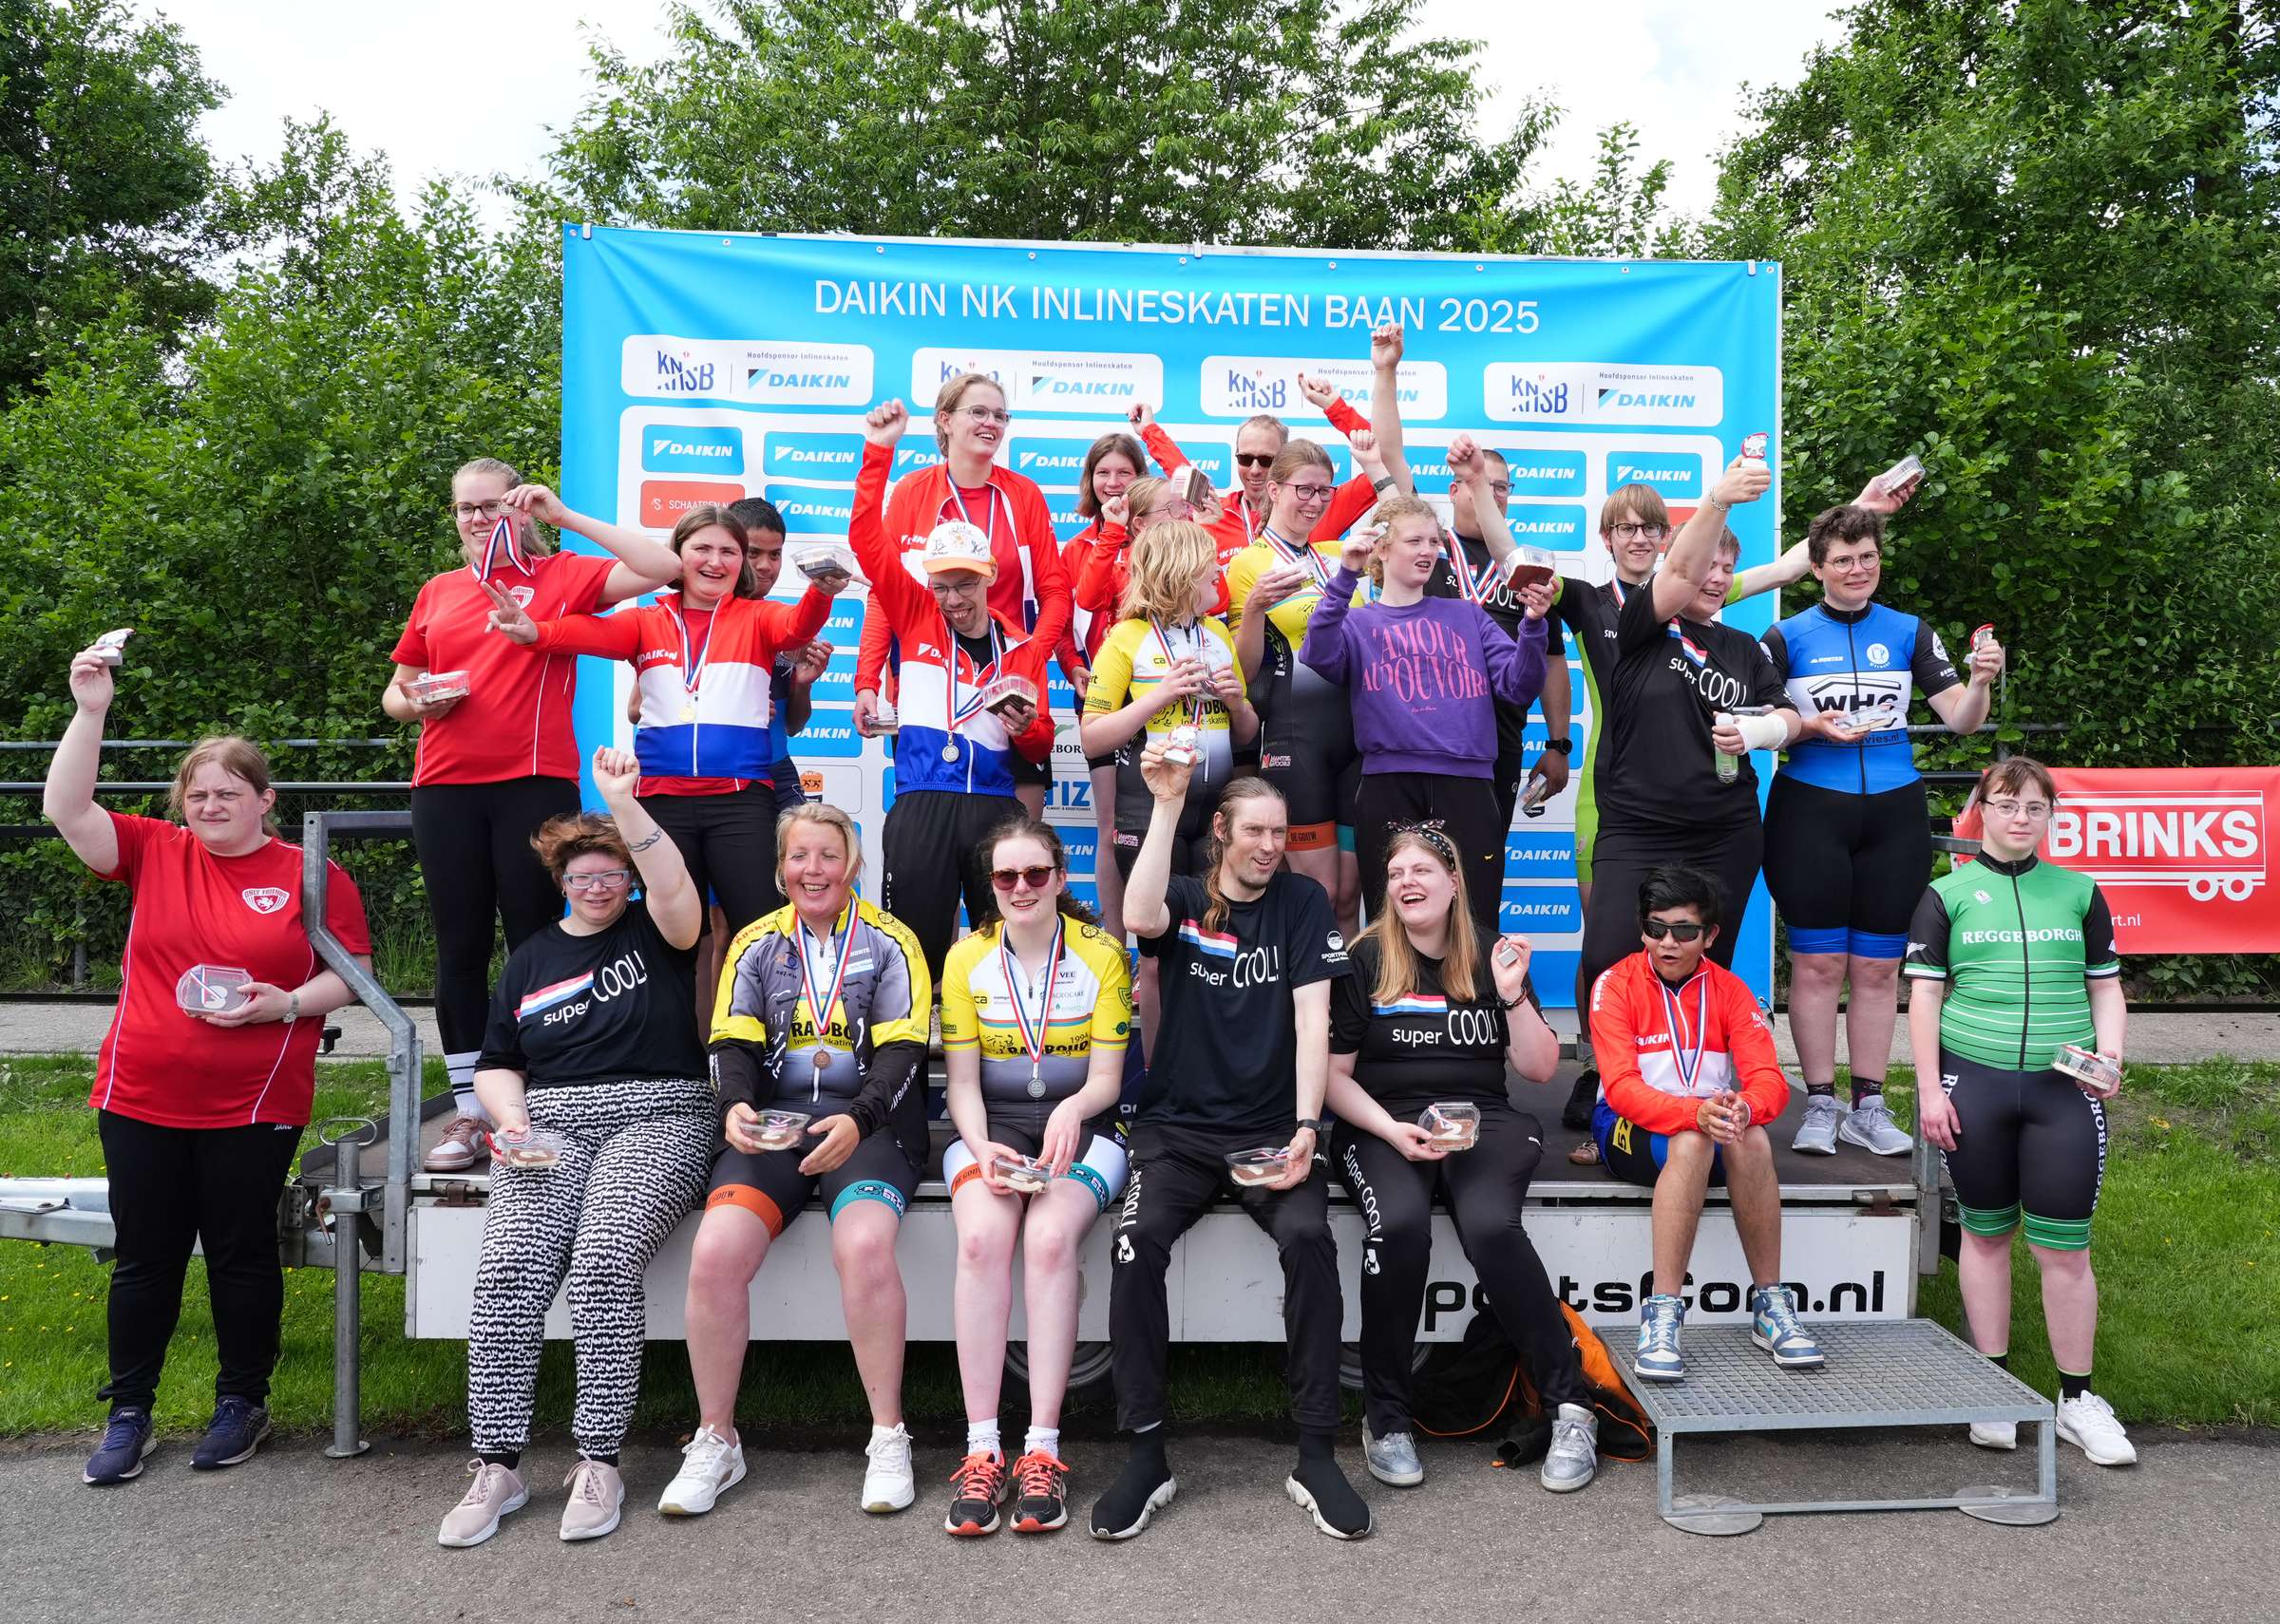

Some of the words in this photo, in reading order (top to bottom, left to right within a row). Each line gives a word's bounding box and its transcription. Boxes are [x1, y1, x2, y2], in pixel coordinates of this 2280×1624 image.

[814, 279, 945, 316] DAIKIN
[961, 284, 1018, 318] NK
[1033, 286, 1309, 327] INLINESKATEN
[1324, 293, 1425, 330] BAAN
[1438, 297, 1540, 334] 2025
[747, 350, 799, 361] Hoofdsponsor
[800, 352, 849, 362] Inlineskaten
[1032, 359, 1084, 370] Hoofdsponsor
[1085, 361, 1133, 370] Inlineskaten
[768, 372, 850, 388] DAIKIN
[1318, 368, 1369, 378] Hoofdsponsor
[1598, 371, 1647, 382] Hoofdsponsor
[1052, 381, 1134, 396] DAIKIN
[1339, 388, 1418, 403] DAIN
[1617, 393, 1696, 408] DAIKIN
[669, 443, 732, 458] DAIKIN
[790, 449, 855, 463] DAIKIN
[1035, 455, 1085, 468] DAIKI
[1515, 466, 1576, 480] DAIKIN
[1633, 469, 1692, 482] DAIKIN
[1513, 520, 1576, 534] DAIKIN
[2048, 809, 2258, 859] BRINKS
[1510, 850, 1571, 861] DAIKIN
[1510, 904, 1571, 916] DAIKIN
[1962, 927, 2082, 944] REGGEBORGH
[542, 999, 591, 1027] super
[1392, 1028, 1443, 1048] super
[1448, 1009, 1500, 1047] COOL!
